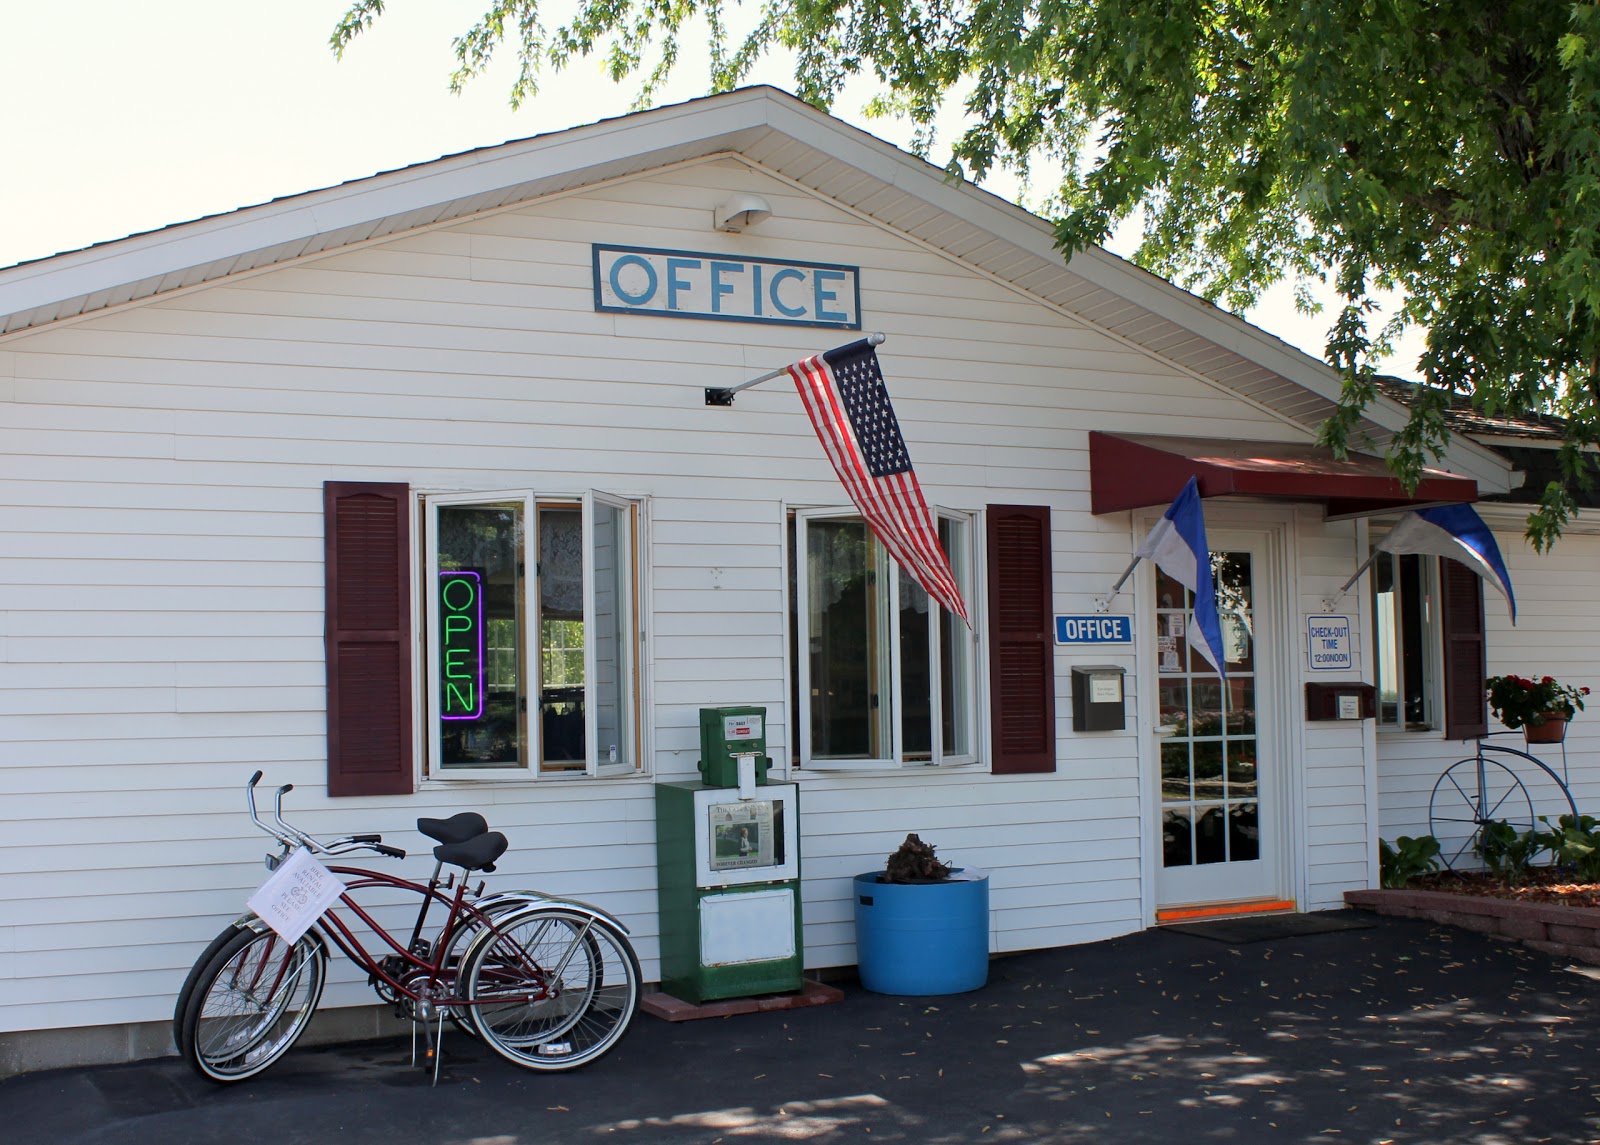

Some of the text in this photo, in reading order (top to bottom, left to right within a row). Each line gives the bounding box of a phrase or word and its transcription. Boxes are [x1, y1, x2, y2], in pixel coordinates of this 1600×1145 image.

[609, 254, 848, 321] OFFICE
[1065, 619, 1123, 639] OFFICE
[1311, 627, 1347, 638] CHECK-OUT
[443, 579, 474, 712] OPEN
[1322, 639, 1338, 649] TIME
[301, 869, 322, 889] RENTAL
[310, 866, 324, 879] BIKE
[281, 892, 301, 911] PLEASE
[271, 904, 290, 921] OFFICE
